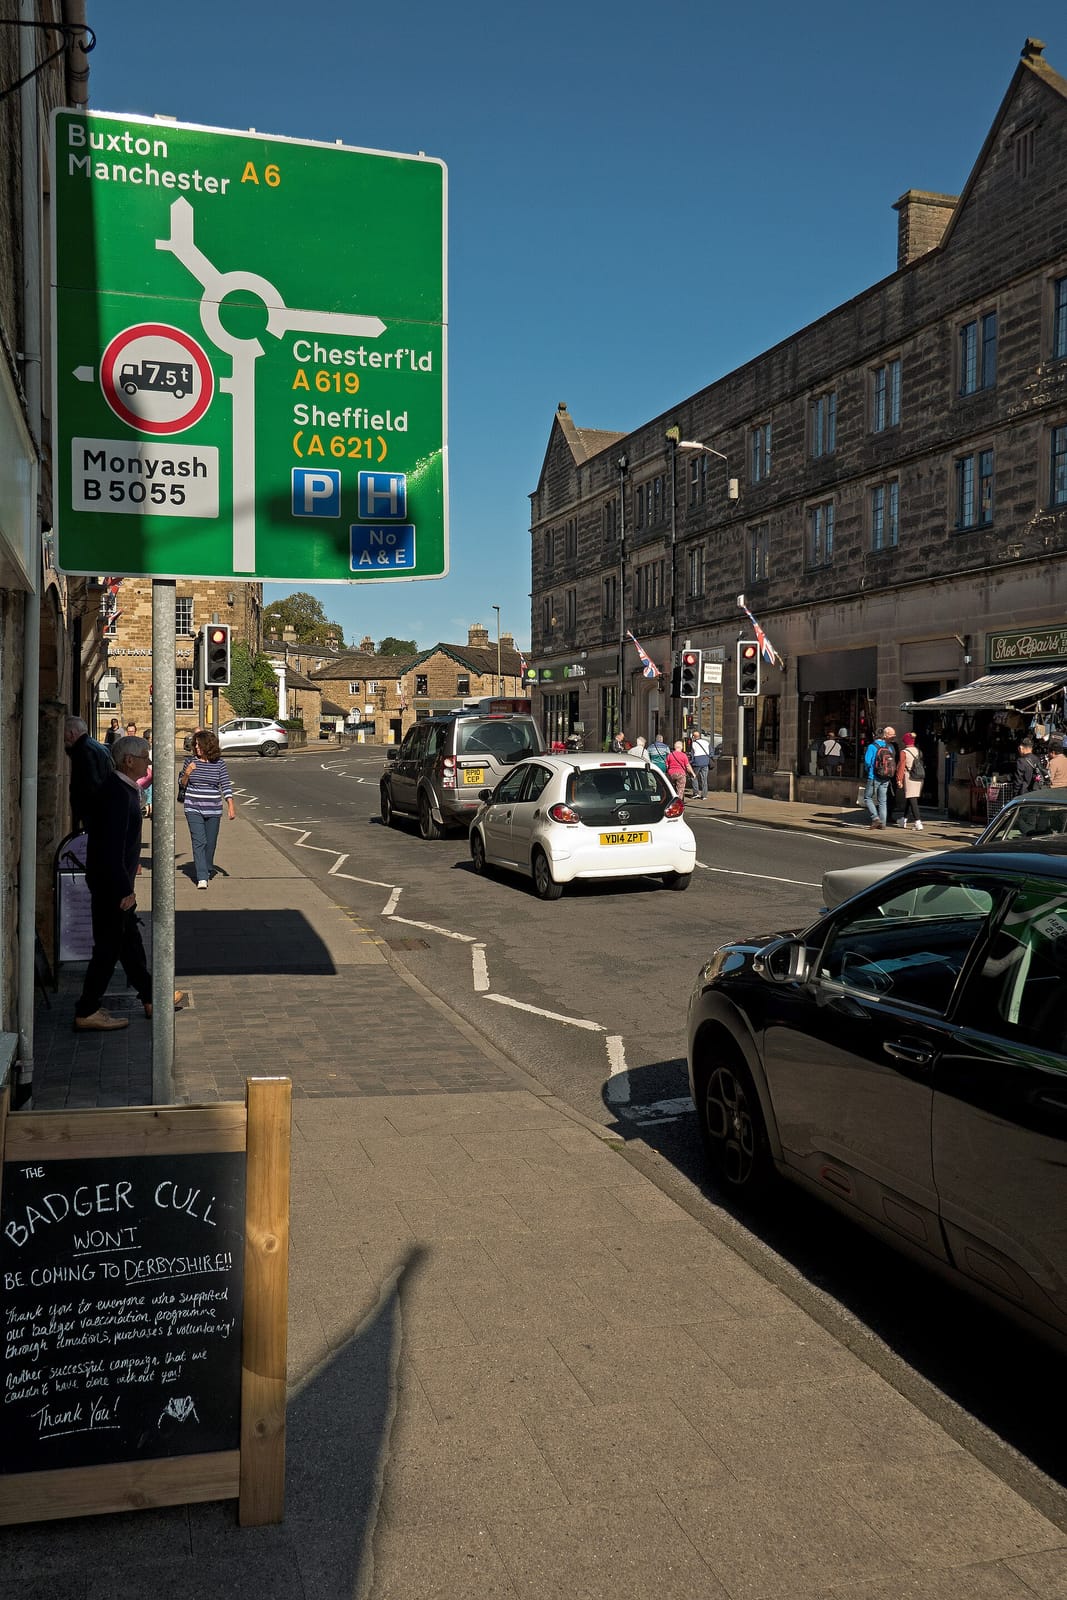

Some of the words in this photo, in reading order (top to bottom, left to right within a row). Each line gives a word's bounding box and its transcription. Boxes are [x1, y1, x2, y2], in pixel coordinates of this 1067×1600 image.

[68, 123, 168, 158] Buxton
[68, 153, 230, 195] Manchester
[292, 403, 409, 432] Sheffield
[83, 449, 208, 479] Monyash
[304, 474, 334, 512] P
[367, 477, 398, 514] H
[369, 530, 397, 545] No
[995, 638, 1017, 659] Shoe
[1016, 635, 1060, 658] Repairs
[605, 834, 625, 844] YD14
[627, 832, 644, 843] ZPT
[20, 1166, 46, 1179] THE
[4, 1181, 135, 1247] BADGER
[154, 1180, 217, 1227] CULL
[72, 1227, 139, 1251] WON'T
[4, 1271, 25, 1290] BE
[31, 1263, 96, 1287] COMING
[99, 1262, 120, 1279] TO
[5, 1304, 43, 1325] Thank
[77, 1298, 92, 1315] to
[95, 1296, 145, 1315] everyone
[151, 1291, 176, 1305] who
[5, 1338, 48, 1362] through
[113, 1326, 164, 1345] purchases
[6, 1326, 25, 1342] our
[5, 1368, 42, 1390] Another
[164, 1350, 187, 1364] that
[55, 1379, 80, 1392] have
[85, 1376, 110, 1388] done
[30, 1402, 83, 1431] Thank
